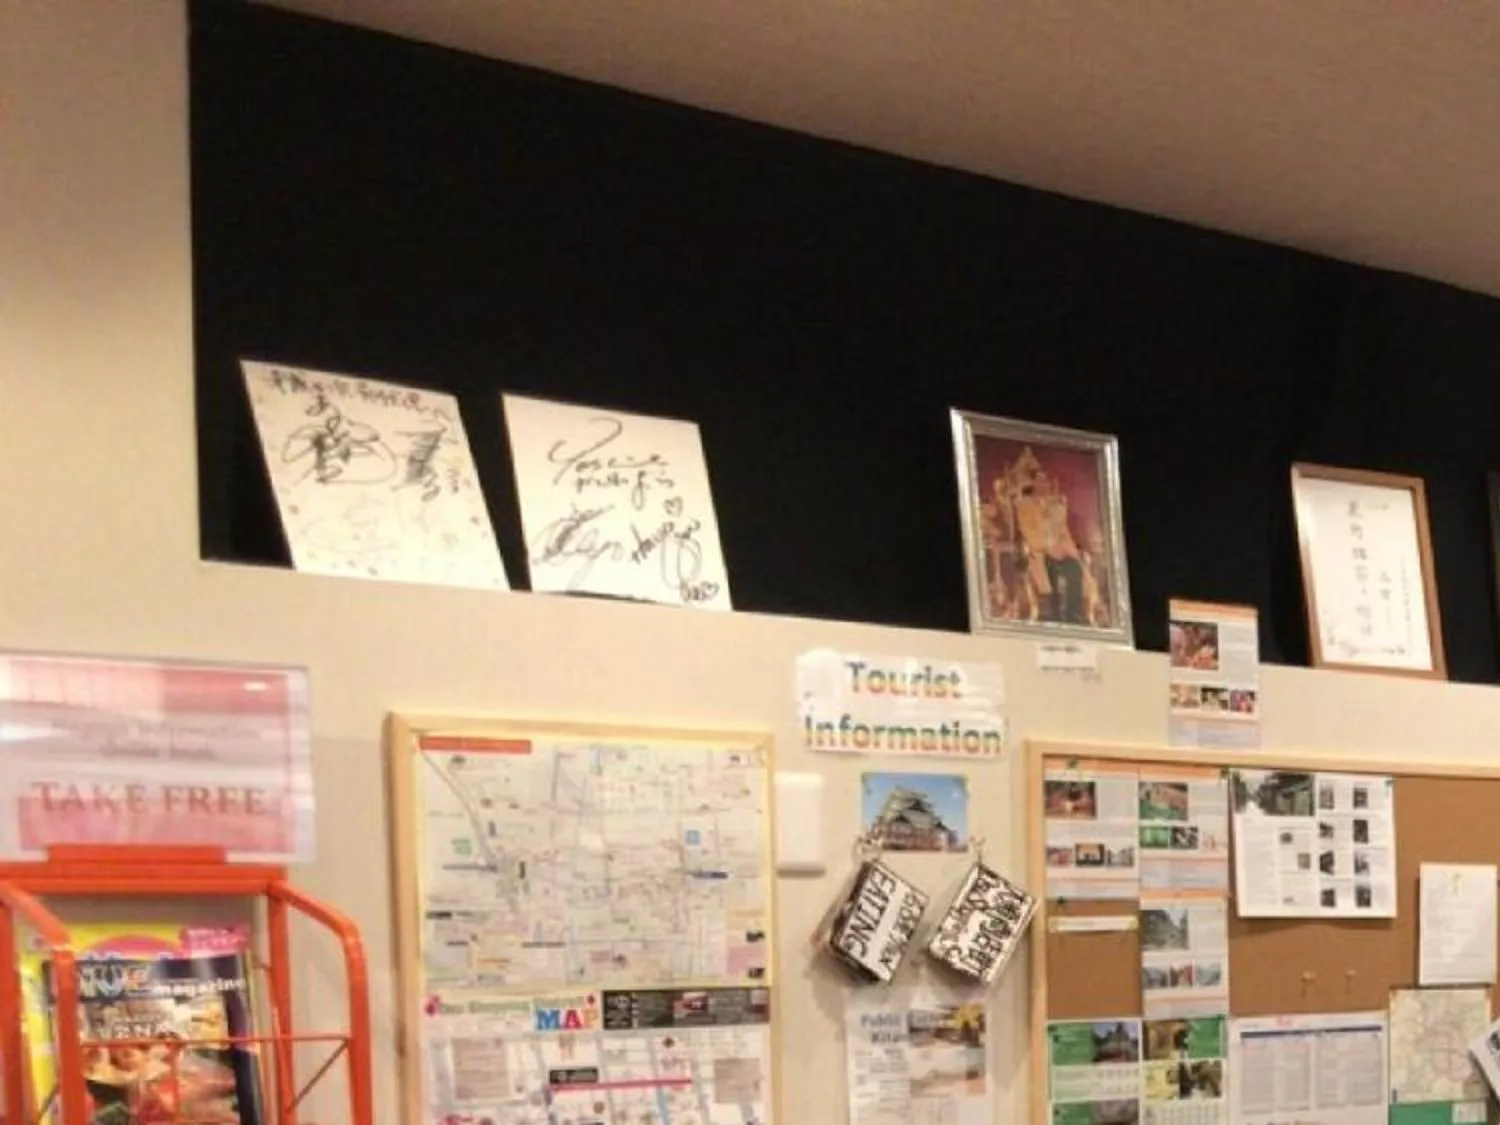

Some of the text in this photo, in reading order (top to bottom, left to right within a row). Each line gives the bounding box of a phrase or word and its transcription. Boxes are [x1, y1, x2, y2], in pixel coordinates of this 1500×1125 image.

[845, 661, 963, 698] Tourist
[31, 781, 267, 816] TAKE FREE
[535, 1007, 598, 1030] MAP
